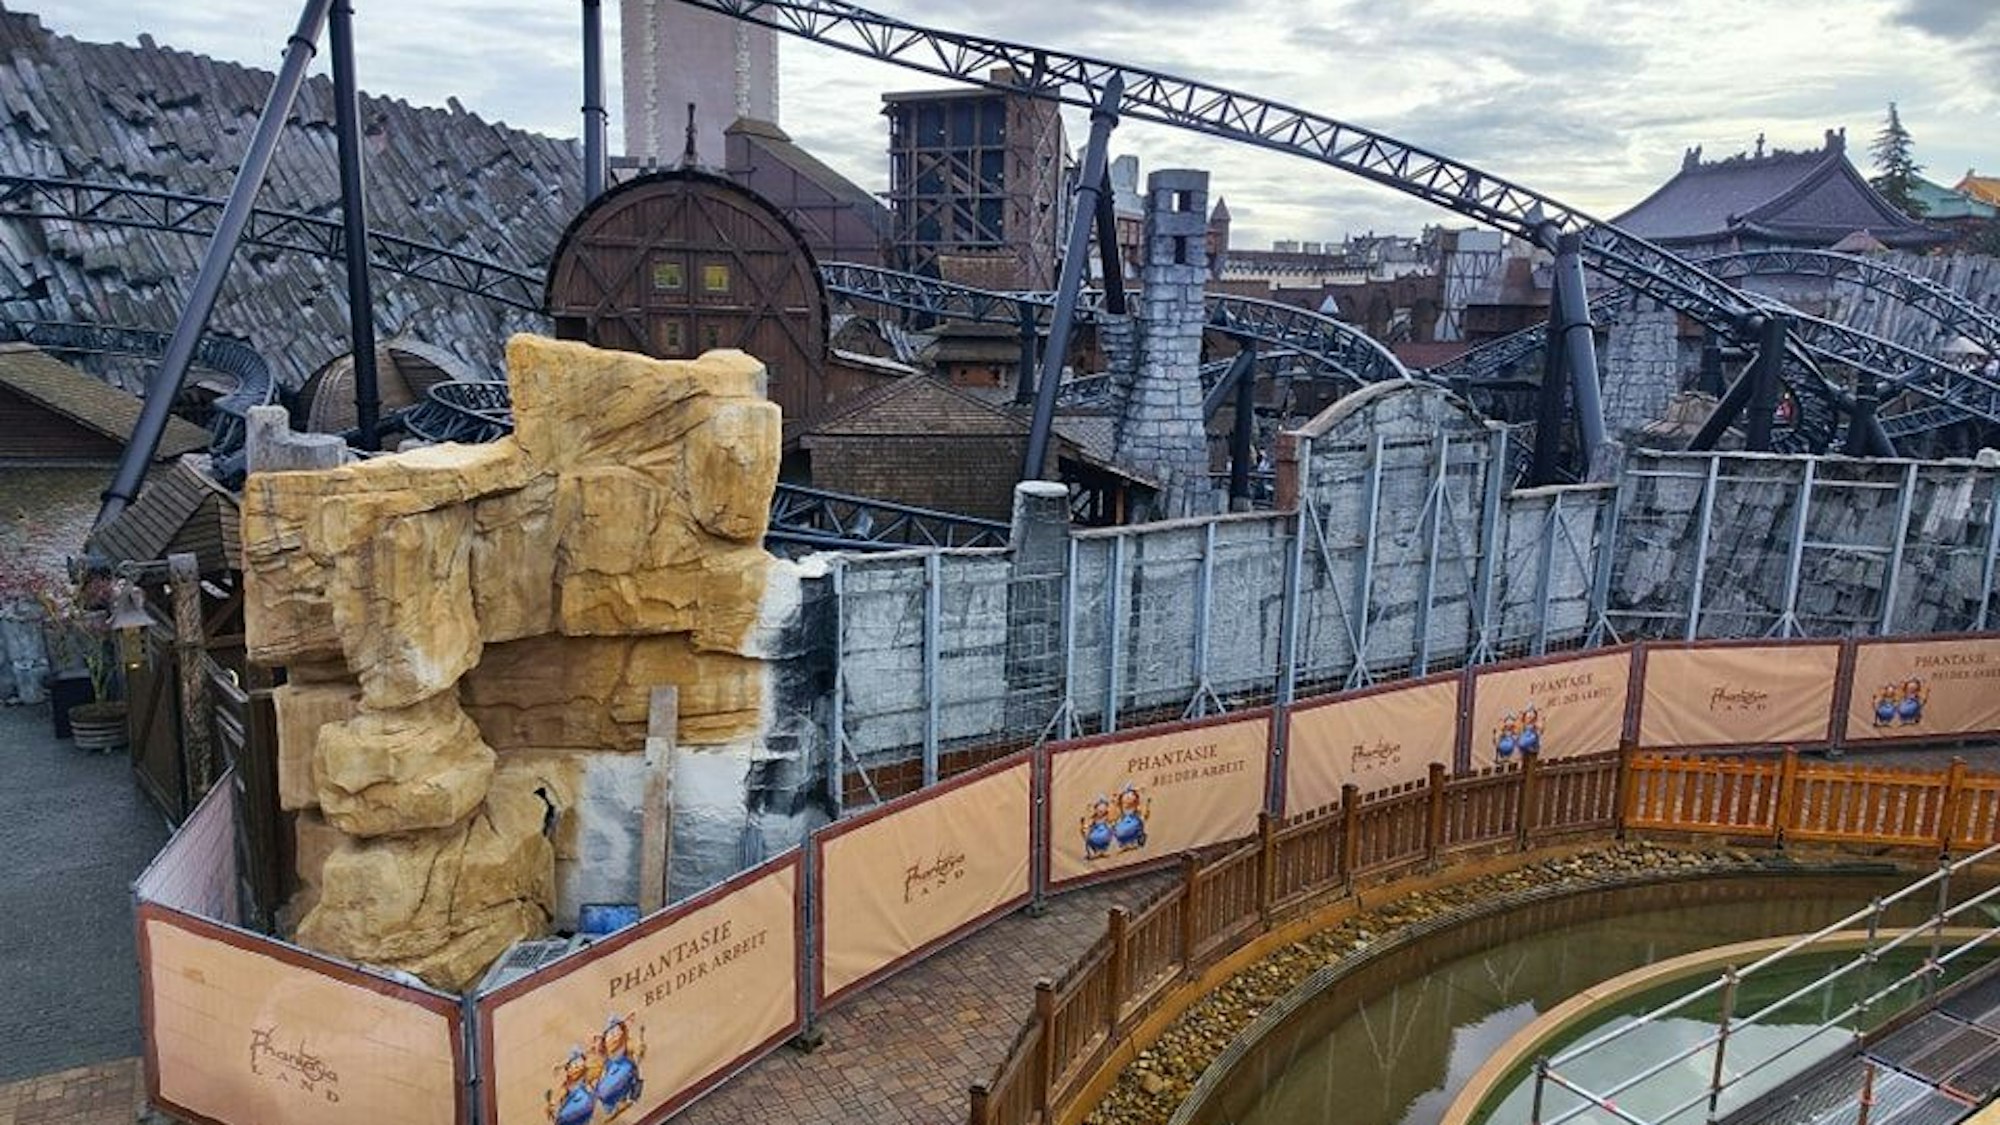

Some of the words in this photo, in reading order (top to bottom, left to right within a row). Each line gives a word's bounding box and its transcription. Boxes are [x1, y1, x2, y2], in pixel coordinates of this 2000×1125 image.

[1128, 744, 1217, 773] PHANTASIE
[1201, 760, 1245, 778] ARBEIT
[608, 920, 732, 999] PHANTASIE
[644, 980, 672, 1007] BEI
[675, 962, 708, 991] DER
[711, 929, 768, 971] ARBEIT
